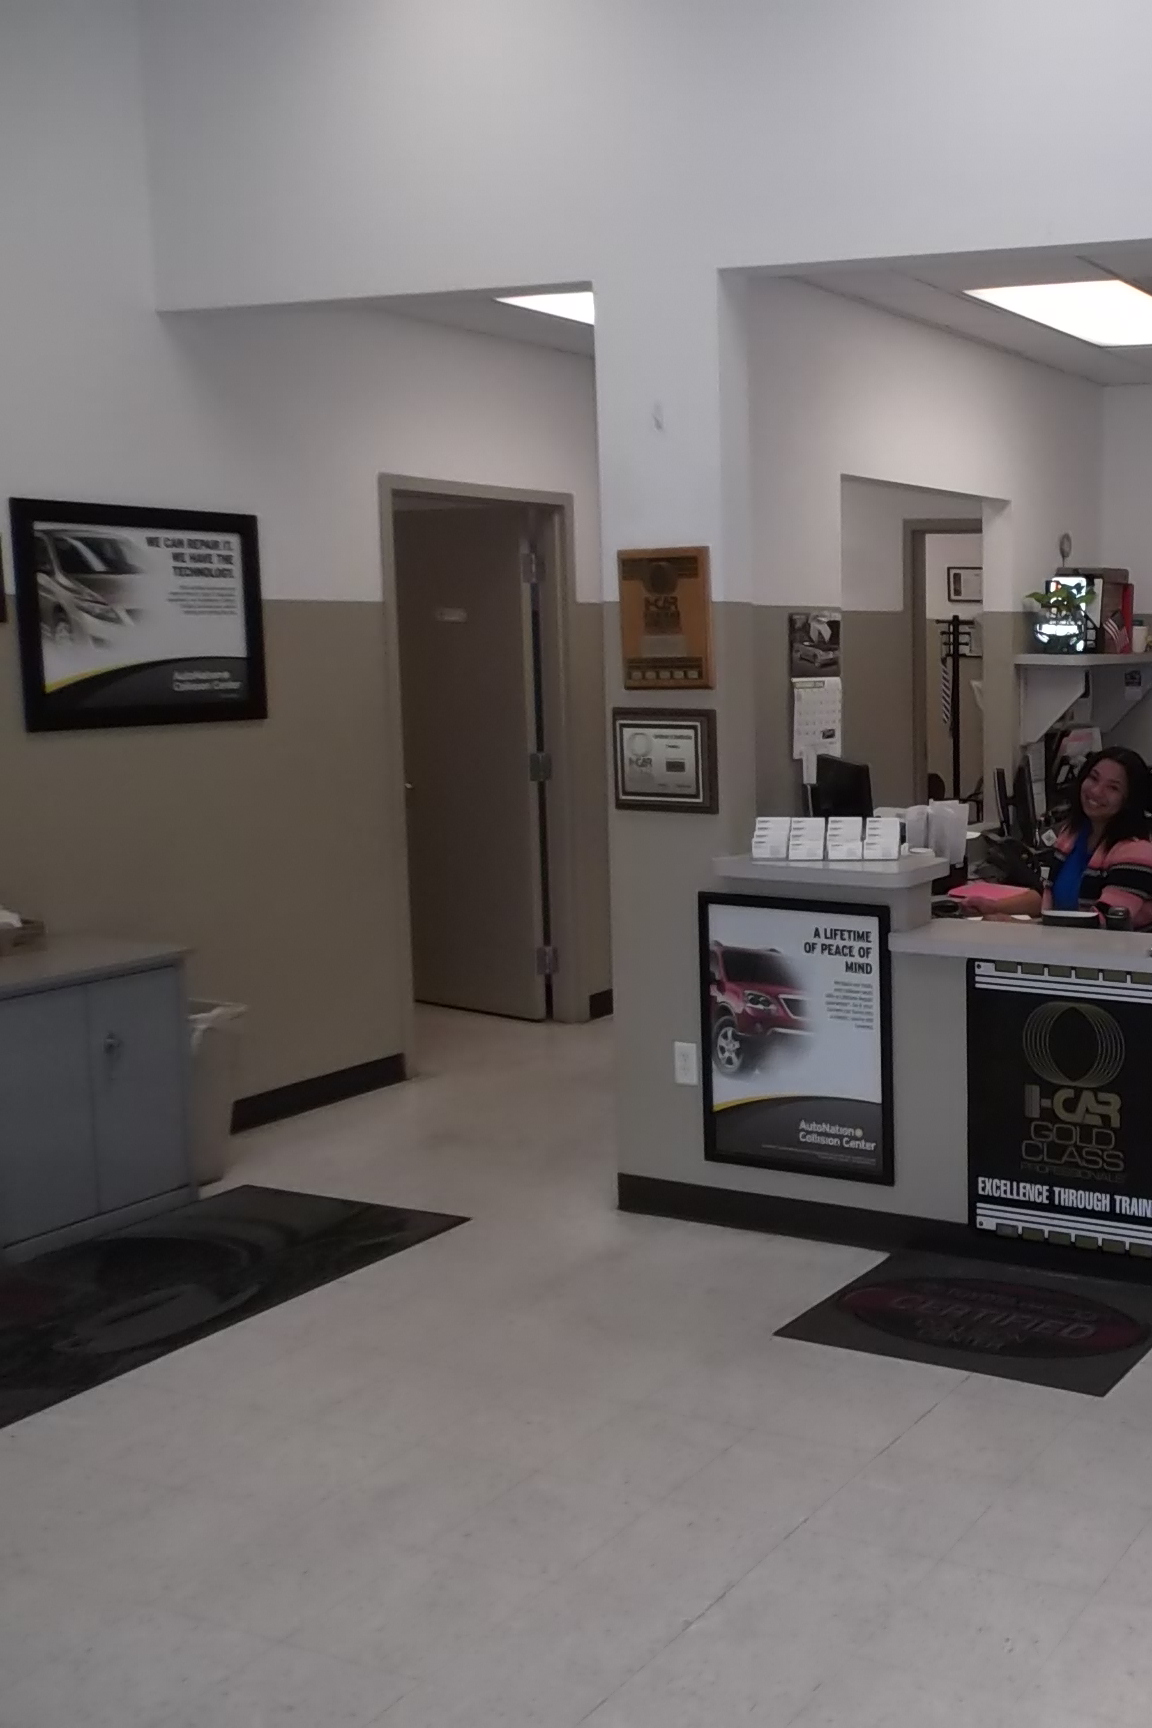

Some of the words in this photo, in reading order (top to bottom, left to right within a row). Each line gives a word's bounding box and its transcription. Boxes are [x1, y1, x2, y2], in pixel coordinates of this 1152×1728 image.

[186, 538, 221, 551] REPAIR
[813, 926, 822, 940] A
[823, 927, 873, 944] LIFETIME
[803, 941, 818, 955] OF
[820, 942, 856, 959] PEACE
[857, 945, 873, 960] OF
[844, 960, 873, 975] MIND
[1024, 1083, 1122, 1130] I-CAR
[799, 1119, 856, 1138] AutoNation
[1030, 1120, 1116, 1150] GOLD
[799, 1131, 842, 1147] Collision
[842, 1137, 877, 1152] Center
[1021, 1140, 1125, 1173] CLASS
[977, 1176, 1051, 1205] EXCELLENCE
[1052, 1185, 1112, 1214] THROUGH
